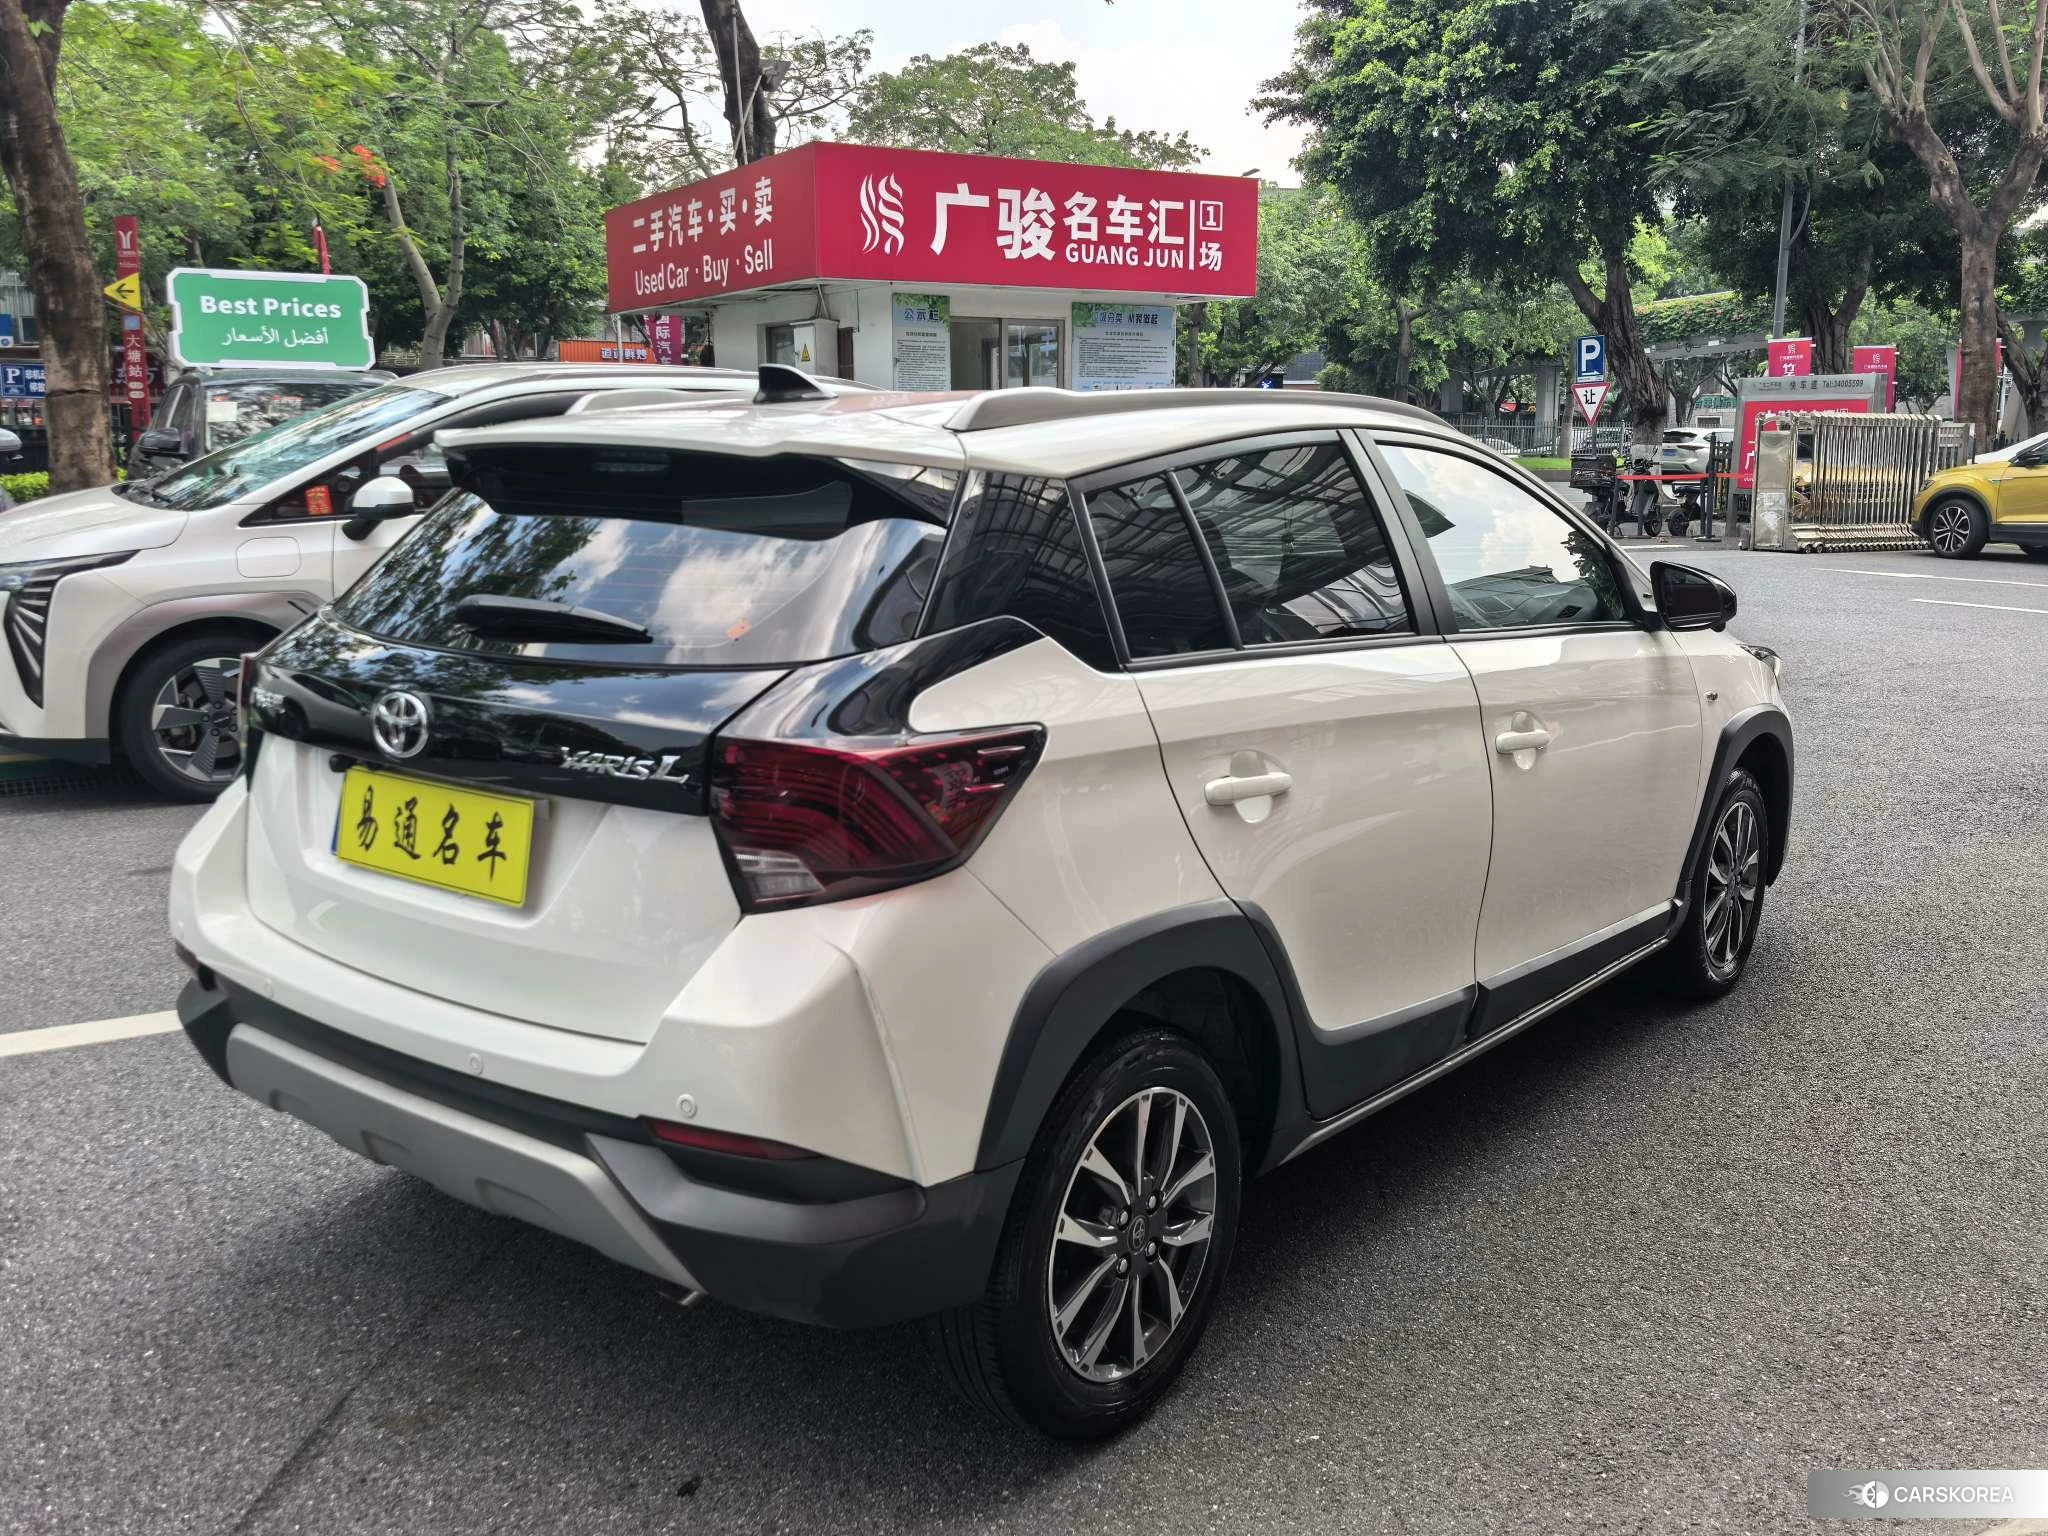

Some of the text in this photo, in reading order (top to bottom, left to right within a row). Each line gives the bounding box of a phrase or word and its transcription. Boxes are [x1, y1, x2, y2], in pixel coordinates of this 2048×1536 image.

[930, 183, 1185, 261] 广骏名车汇
[703, 254, 729, 287] Buy
[744, 238, 773, 275] Sell
[1065, 242, 1184, 269] GUANG JUN
[200, 295, 342, 318] Best Prices
[221, 325, 329, 347] أفضل الأسعار
[127, 334, 143, 377] 大塘站
[1582, 339, 1600, 372] P
[5, 367, 20, 384] P
[1584, 388, 1597, 405] 让
[560, 746, 690, 784] YARIS L
[356, 784, 508, 881] 易通名车
